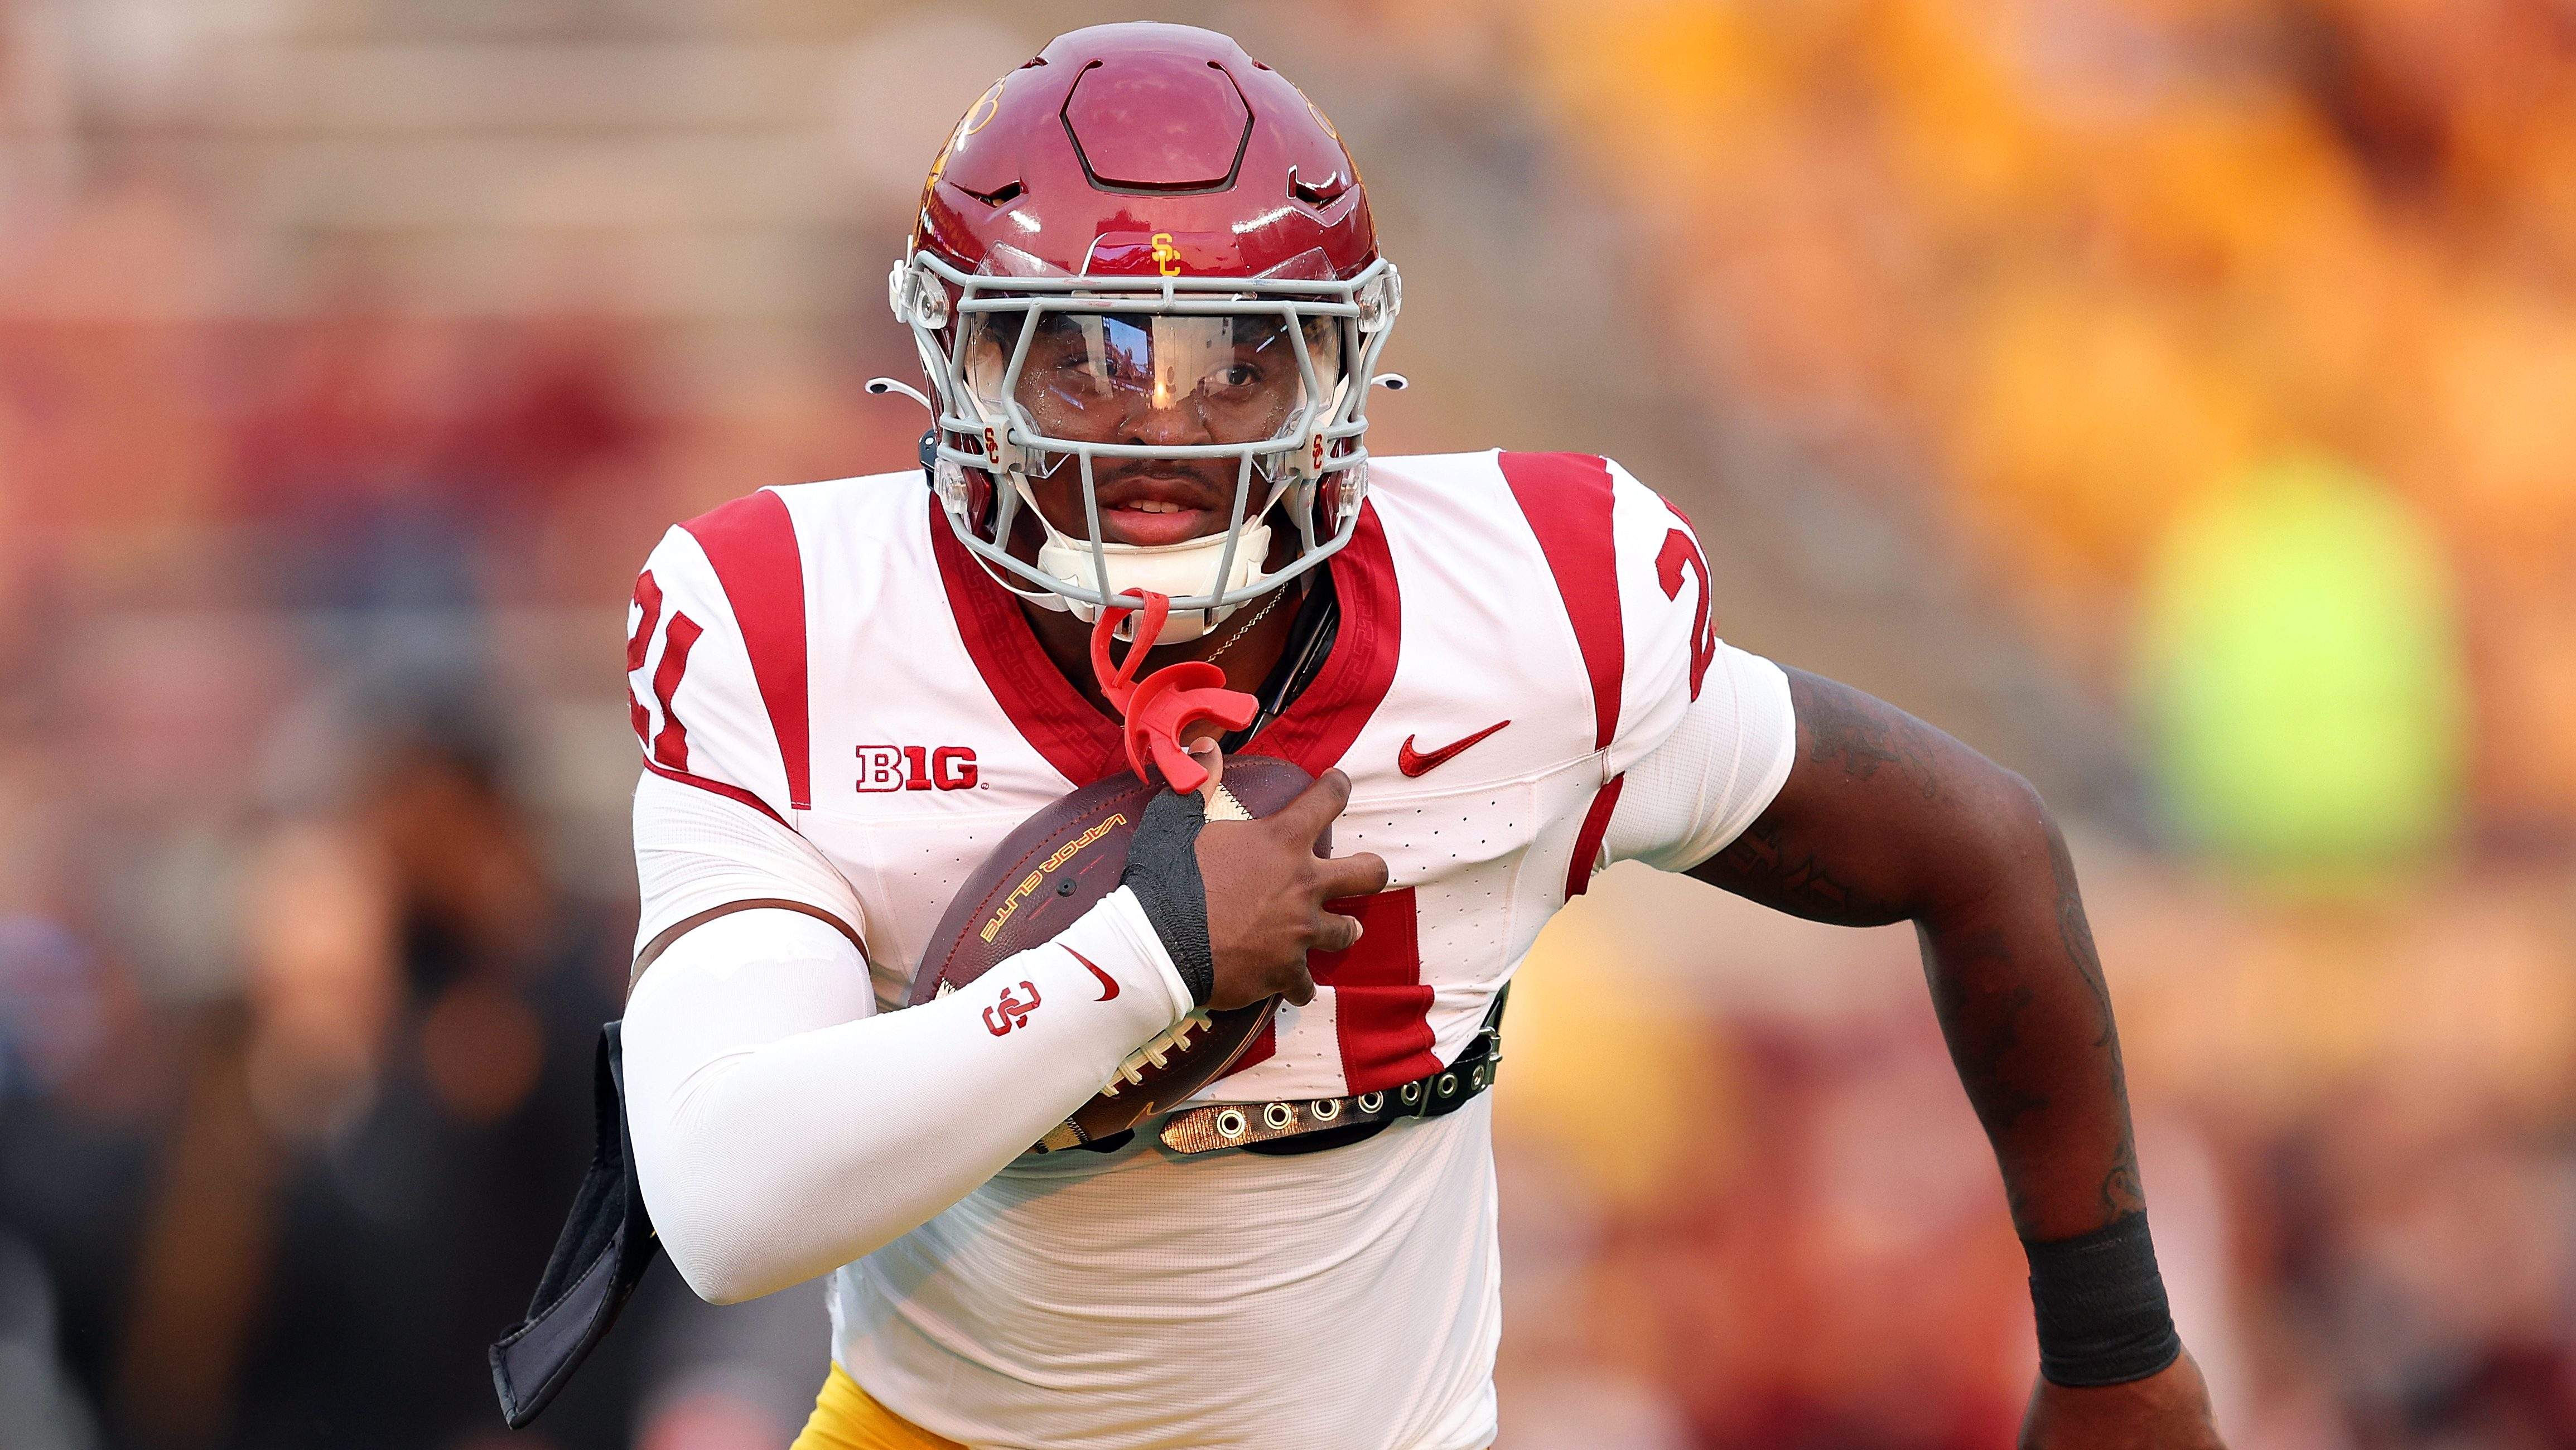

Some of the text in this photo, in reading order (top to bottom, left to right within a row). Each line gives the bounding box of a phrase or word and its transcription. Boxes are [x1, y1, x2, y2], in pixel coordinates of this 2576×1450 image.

[1151, 233, 1181, 276] SC
[984, 427, 999, 463] SC
[1313, 434, 1323, 469] SC
[1655, 493, 1716, 702] 2
[627, 569, 704, 772] 21
[980, 813, 1127, 942] VAPOR ELITE
